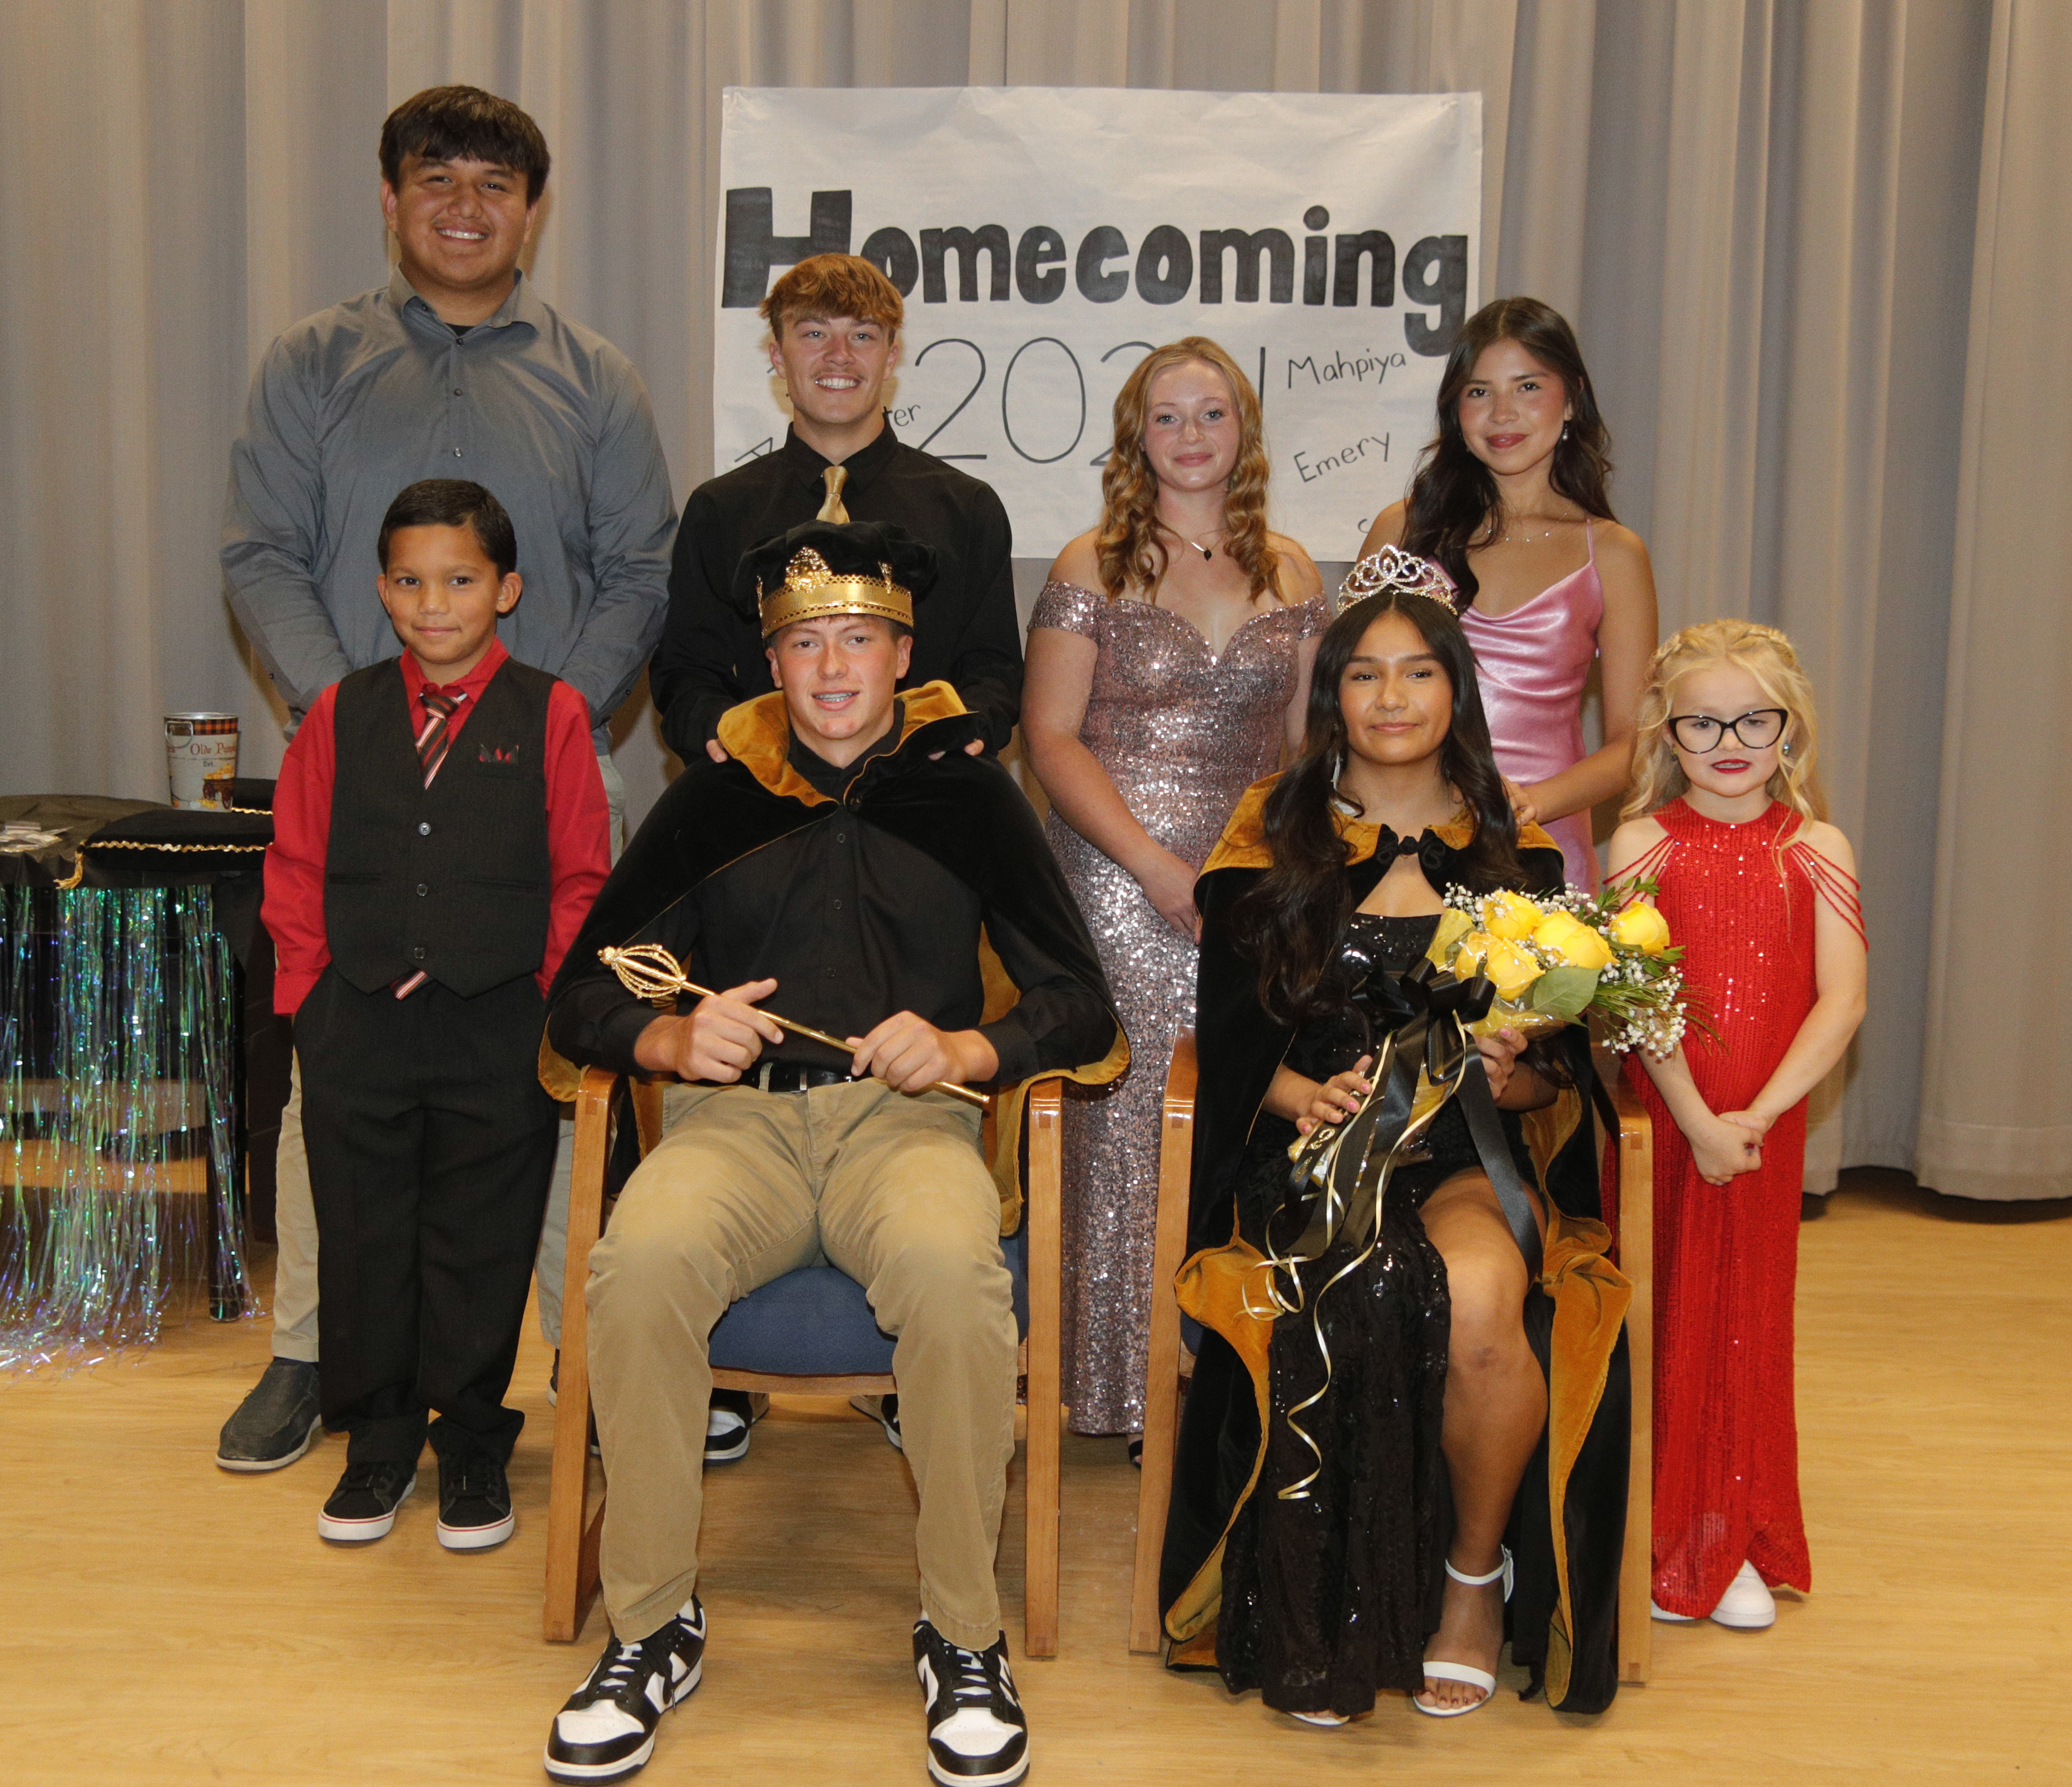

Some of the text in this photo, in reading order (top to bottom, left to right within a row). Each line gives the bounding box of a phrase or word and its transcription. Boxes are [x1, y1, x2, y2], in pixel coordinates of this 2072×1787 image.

[722, 187, 1468, 356] Homecoming
[915, 336, 1265, 466] 20
[1288, 348, 1406, 389] Mahpiya
[1293, 432, 1389, 483] Emery
